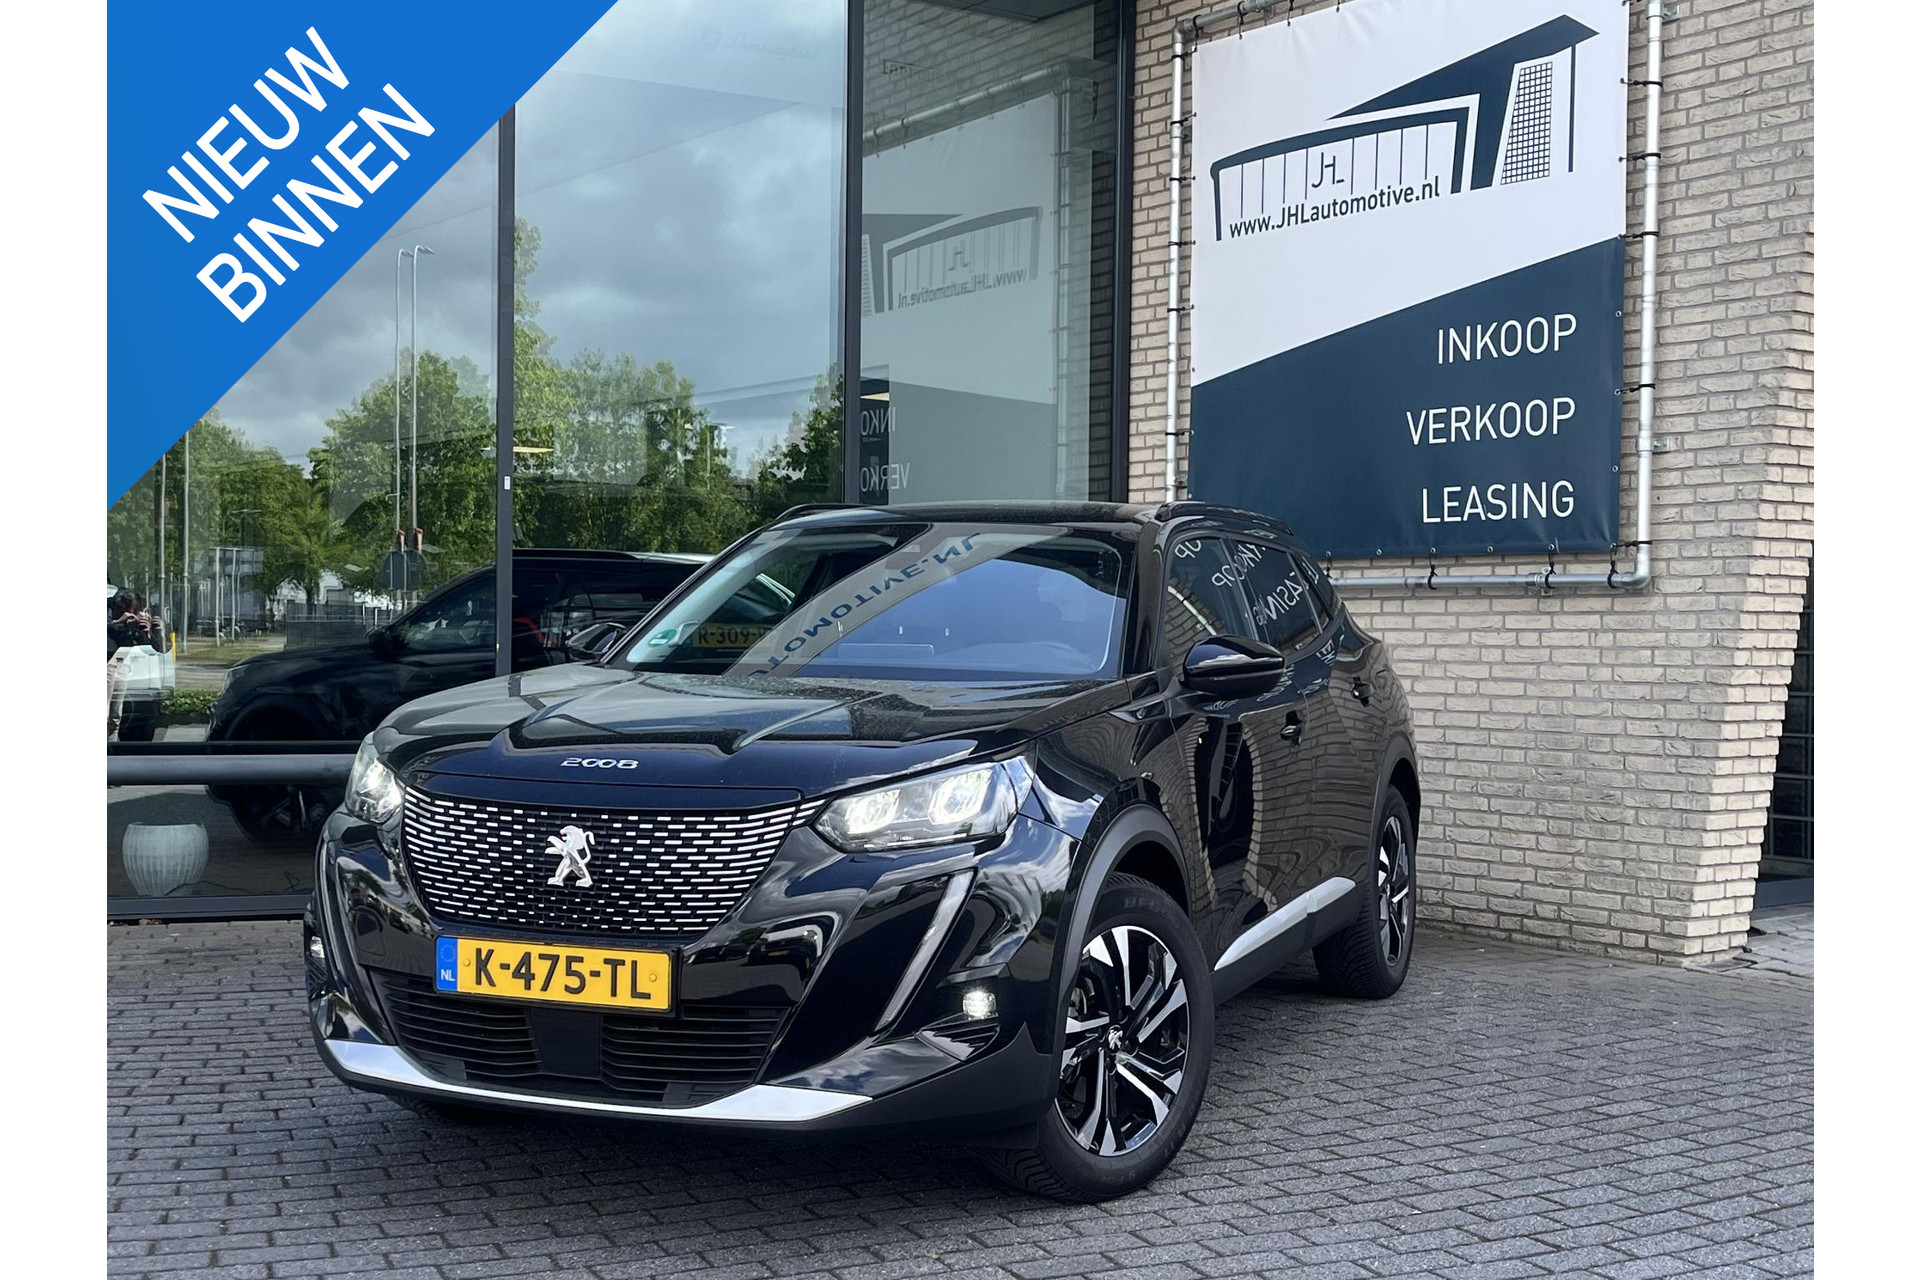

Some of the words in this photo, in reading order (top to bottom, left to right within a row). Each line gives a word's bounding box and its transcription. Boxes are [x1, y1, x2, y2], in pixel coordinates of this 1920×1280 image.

[1229, 176, 1440, 238] www.JHLautomotive.nl
[1437, 313, 1577, 364] INKOOP
[1406, 397, 1576, 445] VERKOOP
[1422, 480, 1575, 523] LEASING
[560, 757, 639, 769] 2008
[440, 969, 455, 982] NL
[474, 947, 651, 1000] K-475-TL
